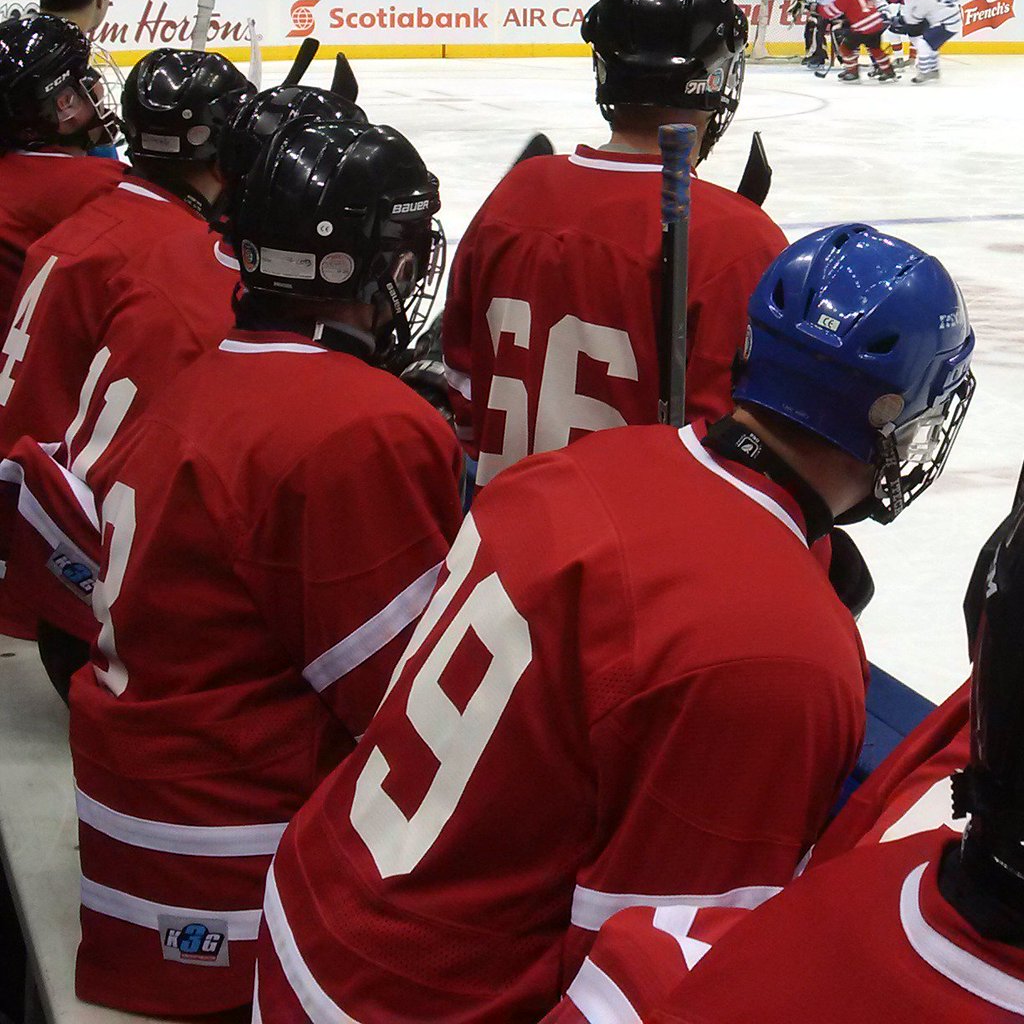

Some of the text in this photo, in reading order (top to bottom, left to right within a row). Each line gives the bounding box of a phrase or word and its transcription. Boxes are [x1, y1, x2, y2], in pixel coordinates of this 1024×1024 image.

[329, 6, 488, 29] Scotiabank
[503, 7, 547, 28] AIR
[964, 2, 1011, 27] French's
[44, 69, 70, 93] CCM
[392, 199, 429, 215] BAUER
[166, 923, 222, 953] K3G
